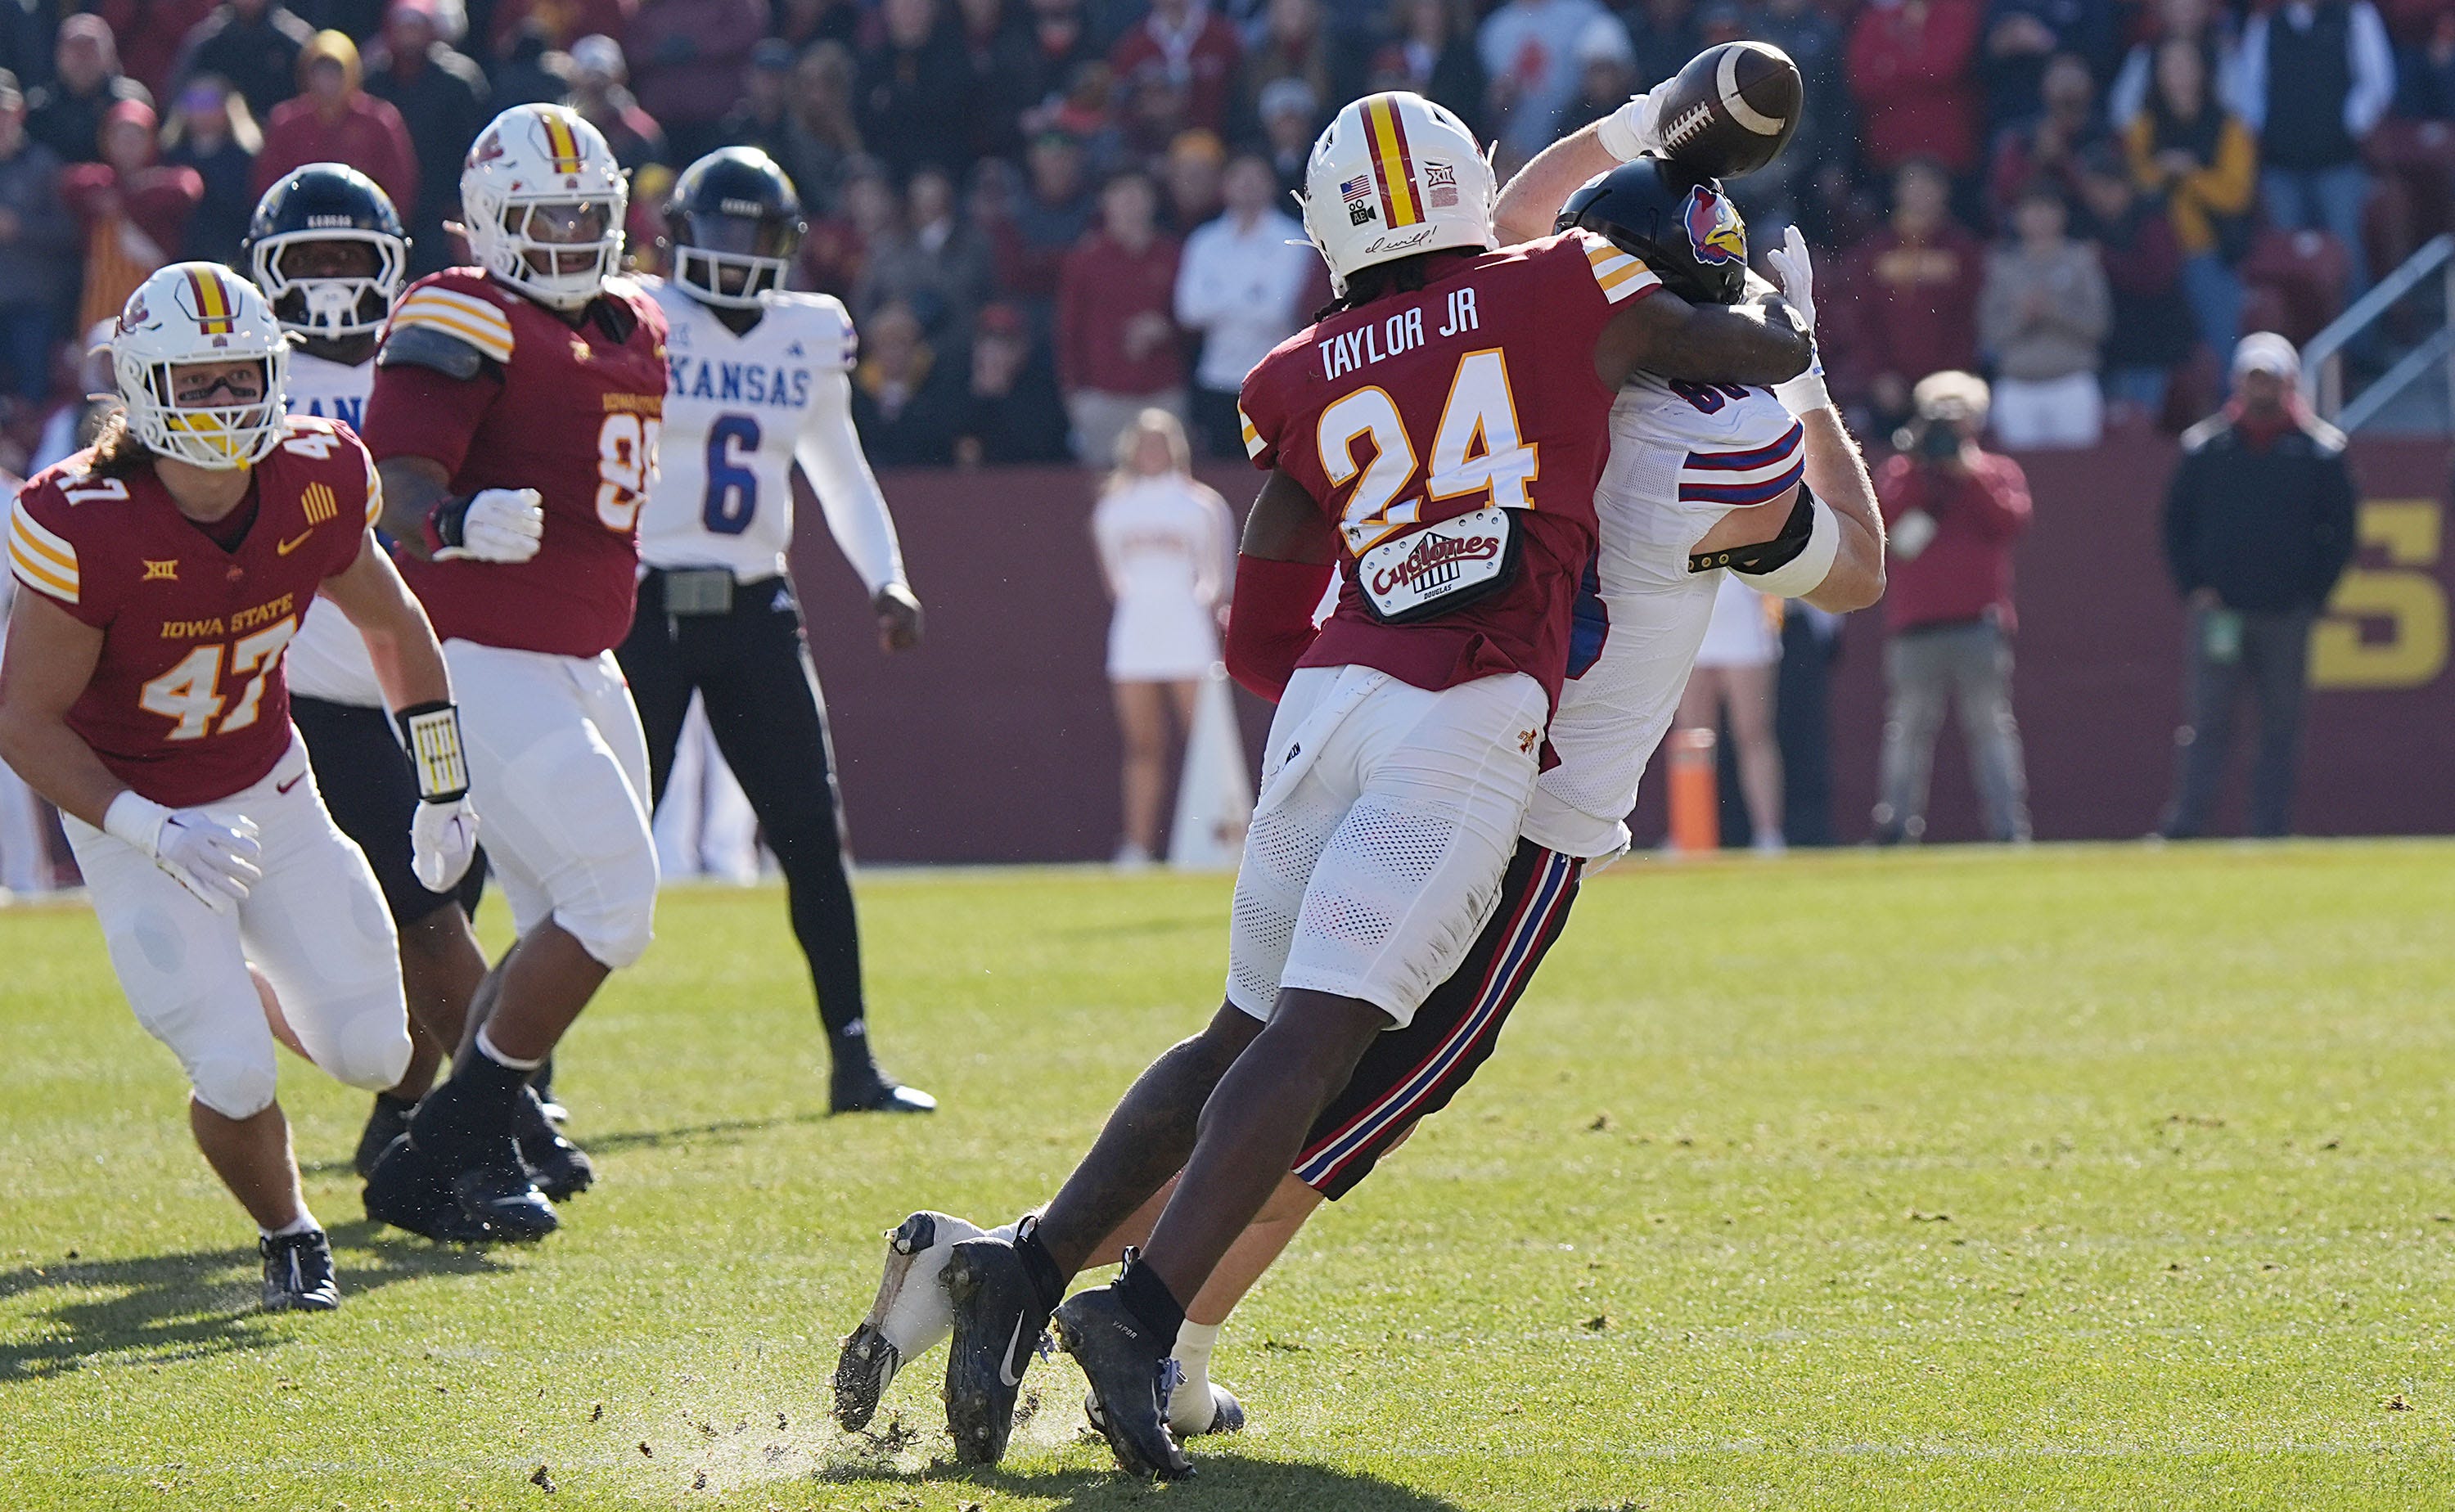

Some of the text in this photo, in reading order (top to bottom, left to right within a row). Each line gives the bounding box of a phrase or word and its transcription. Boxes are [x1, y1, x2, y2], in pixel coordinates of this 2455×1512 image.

[1353, 210, 1368, 224] AE
[1318, 287, 1479, 381] TAYLOR JR
[668, 355, 812, 410] KANSAS
[703, 413, 761, 536] 6
[1316, 347, 1539, 559] 24
[142, 560, 179, 582] XII
[1372, 536, 1499, 596] Cyclones
[1423, 584, 1453, 600] DOUGLAS
[2308, 499, 2448, 690] S
[160, 592, 294, 638] IOWA STATE
[138, 613, 298, 741] 47
[1112, 1321, 1138, 1339] VAPOR
